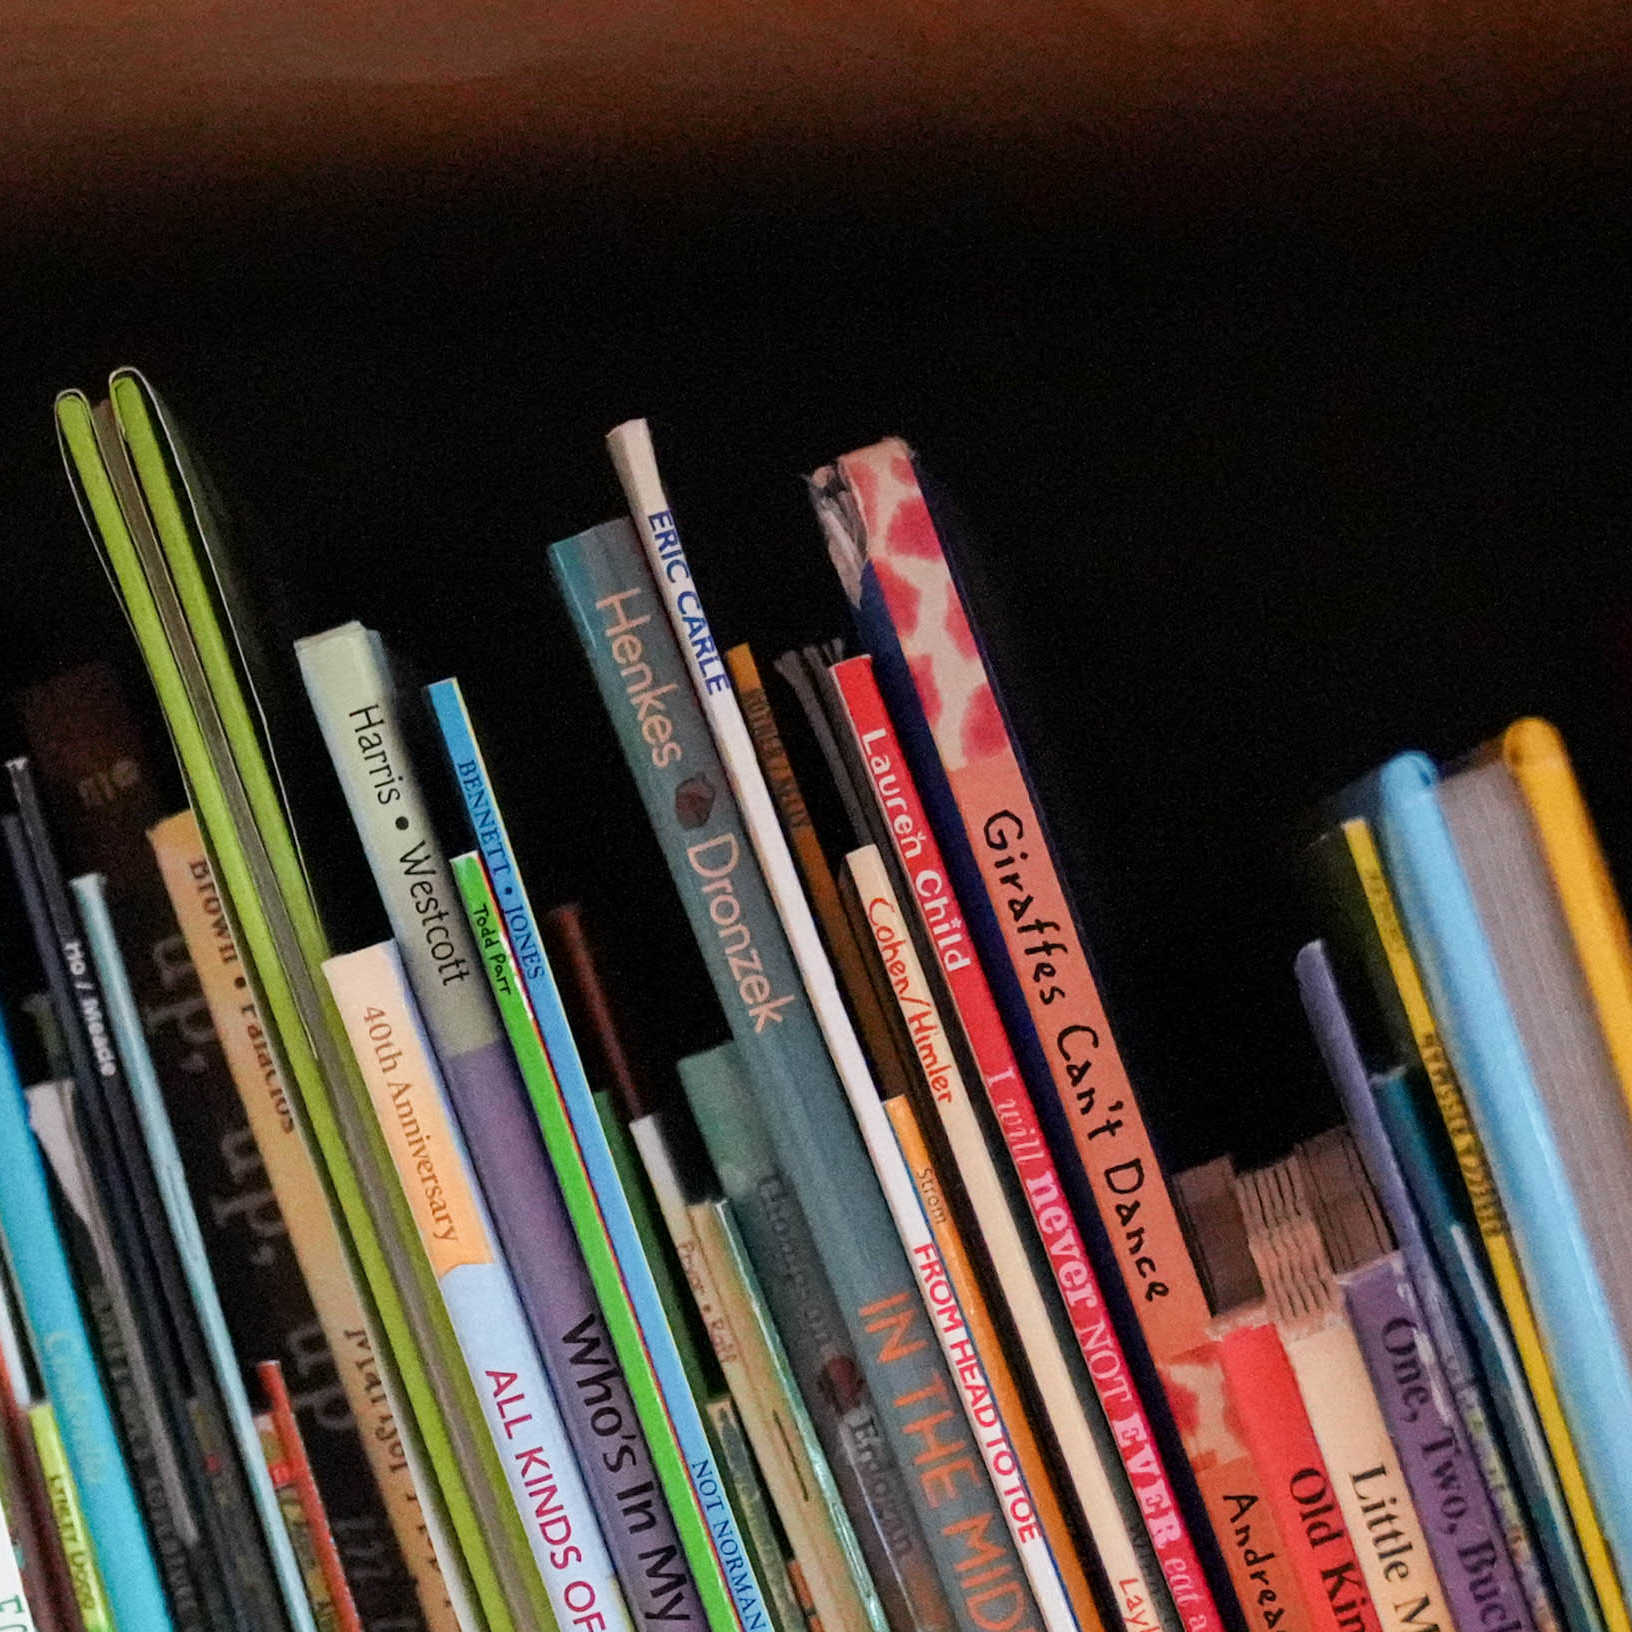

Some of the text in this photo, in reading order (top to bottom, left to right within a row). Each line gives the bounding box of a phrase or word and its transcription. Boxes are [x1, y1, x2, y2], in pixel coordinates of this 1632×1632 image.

[639, 507, 733, 698] ERIC CARLE
[344, 702, 475, 989] Harris Westcott
[451, 758, 547, 983] BENNETT JONES
[587, 586, 701, 771] Henkes
[678, 830, 799, 1036] Dronzek
[857, 725, 978, 975] Lauren Child
[356, 1001, 406, 1079] 40th
[859, 894, 962, 1108] Cohen/Himler
[968, 803, 1190, 1304] Giraffes Can't Dance
[983, 1063, 1015, 1087] I
[993, 1092, 1045, 1165] will
[378, 1076, 466, 1248] Anniversary
[1023, 1169, 1103, 1314] never
[554, 1314, 651, 1482] Who's
[850, 1289, 926, 1370] IN
[909, 1240, 1043, 1545] FROM HEAD TO TOE
[1074, 1316, 1135, 1410] NOT
[483, 1361, 538, 1442] ALL
[513, 1443, 585, 1572] KINDS
[689, 1458, 723, 1506] NOT
[879, 1366, 982, 1514] THE
[1109, 1410, 1188, 1549] EVER
[1366, 1312, 1445, 1426] One,
[1411, 1428, 1486, 1536] Two,
[613, 1479, 667, 1538] In
[1281, 1462, 1347, 1551] Old
[1344, 1461, 1423, 1587] Little
[624, 1541, 699, 1632] My
[1160, 1550, 1206, 1611] eat
